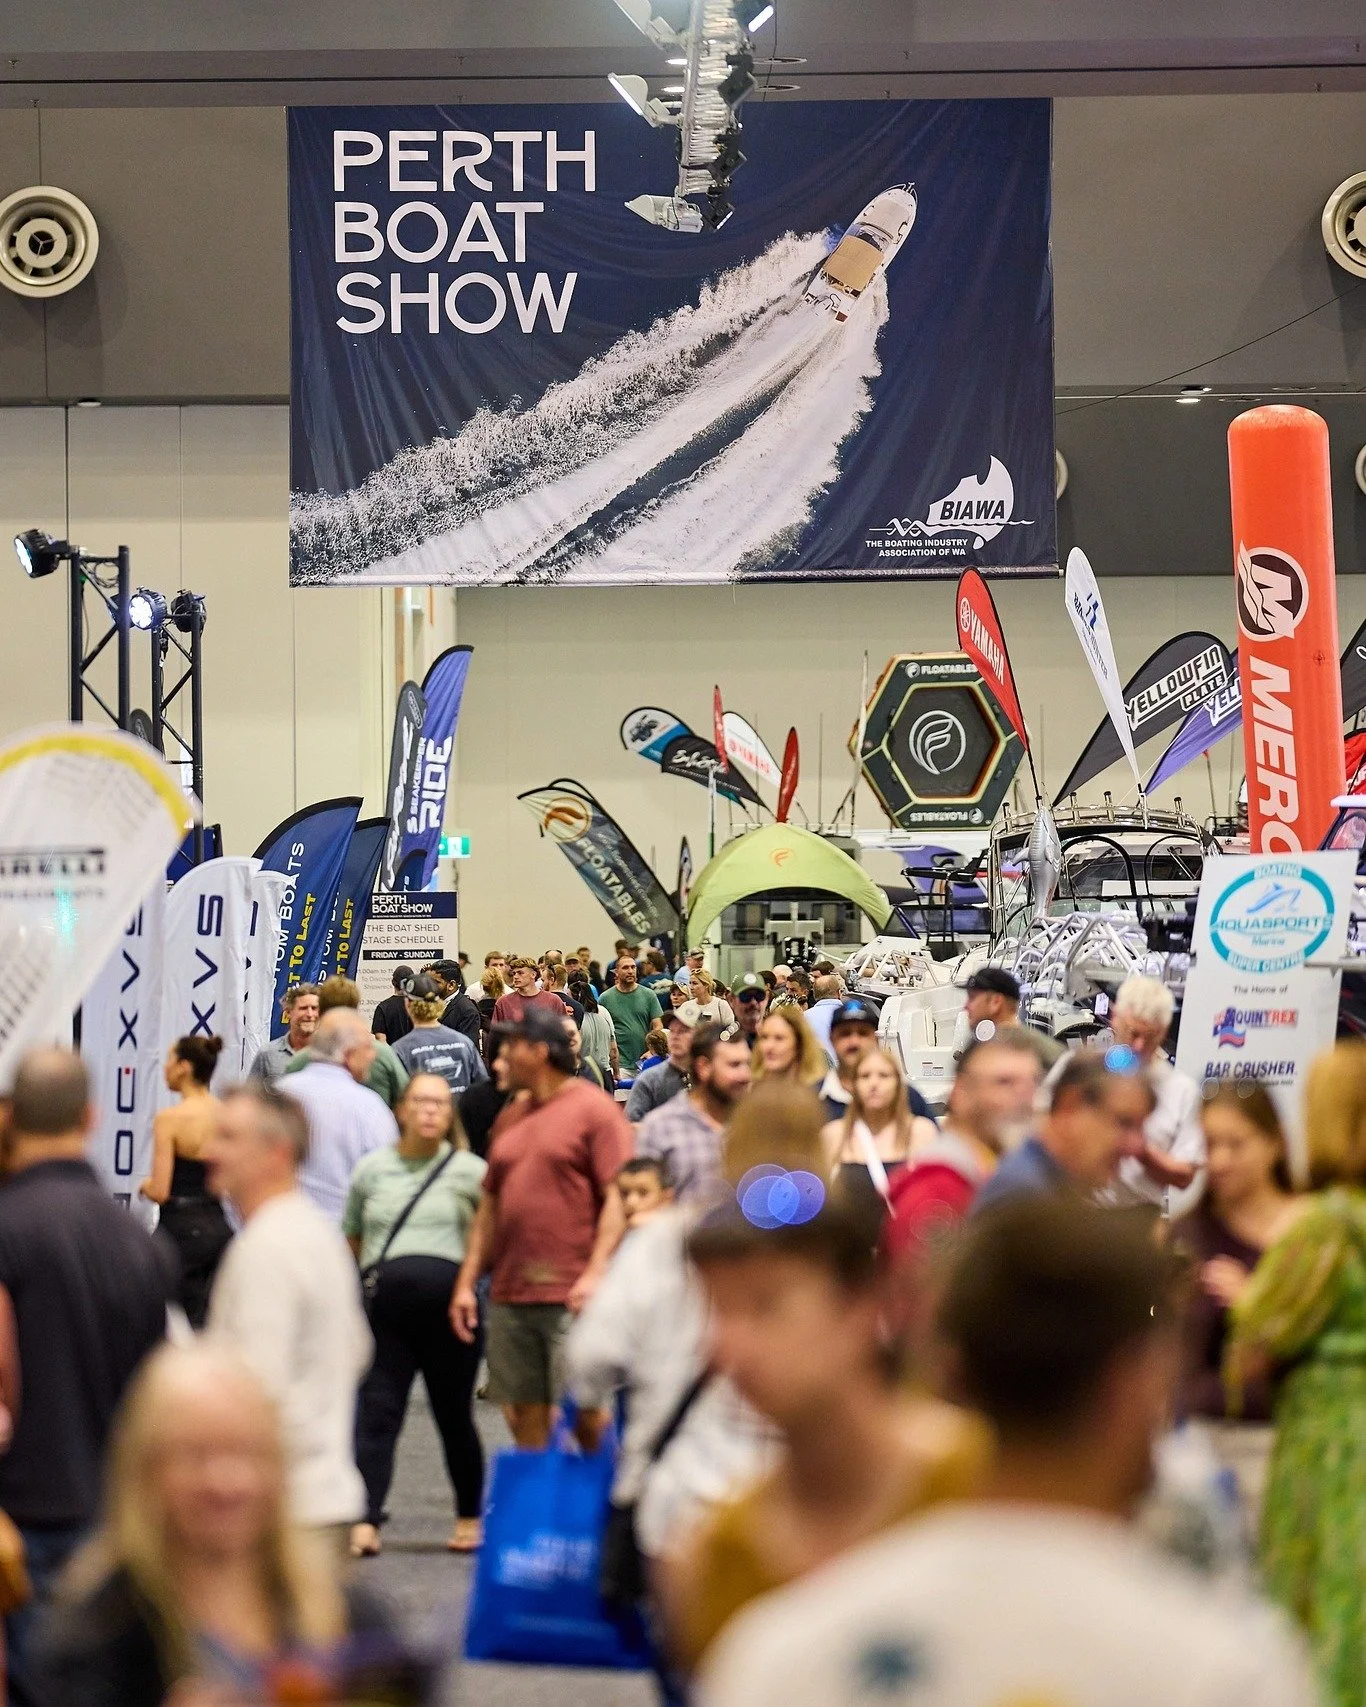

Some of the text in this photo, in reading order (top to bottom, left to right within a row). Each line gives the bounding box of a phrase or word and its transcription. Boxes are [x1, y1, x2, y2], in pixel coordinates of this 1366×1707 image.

[333, 130, 596, 192] PERTH
[334, 201, 544, 263] BOAT
[335, 271, 578, 334] SHOW
[940, 500, 1005, 520] BIAWA
[878, 548, 966, 557] ASSOCIATION OF WA
[884, 539, 923, 547] BOATING
[924, 538, 968, 547] INDUSTRY
[969, 608, 1005, 686] YAMAHA
[920, 663, 977, 675] FLOATABLES
[1125, 645, 1222, 731] YELLOWFIN
[1182, 672, 1226, 708] PLATE
[410, 736, 427, 816] SEAKEEPER
[417, 735, 454, 835] RIDE
[575, 836, 651, 934] FLOATABLES
[371, 894, 407, 904] PERTH
[371, 903, 433, 914] BOAT SHOW
[295, 893, 317, 941] LAST
[338, 899, 355, 939] LAST
[387, 924, 411, 932] BOAT
[414, 924, 440, 932] SHED
[363, 935, 444, 944] STAGE SCHEDULE
[289, 945, 305, 967] TO
[336, 942, 350, 962] TO
[371, 951, 398, 959] FRIDAY
[403, 951, 436, 959] SUNDAY
[1233, 983, 1289, 994] The Home of
[1235, 1008, 1298, 1026] QUINTREX
[1204, 1060, 1297, 1078] BAR CRUSHER
